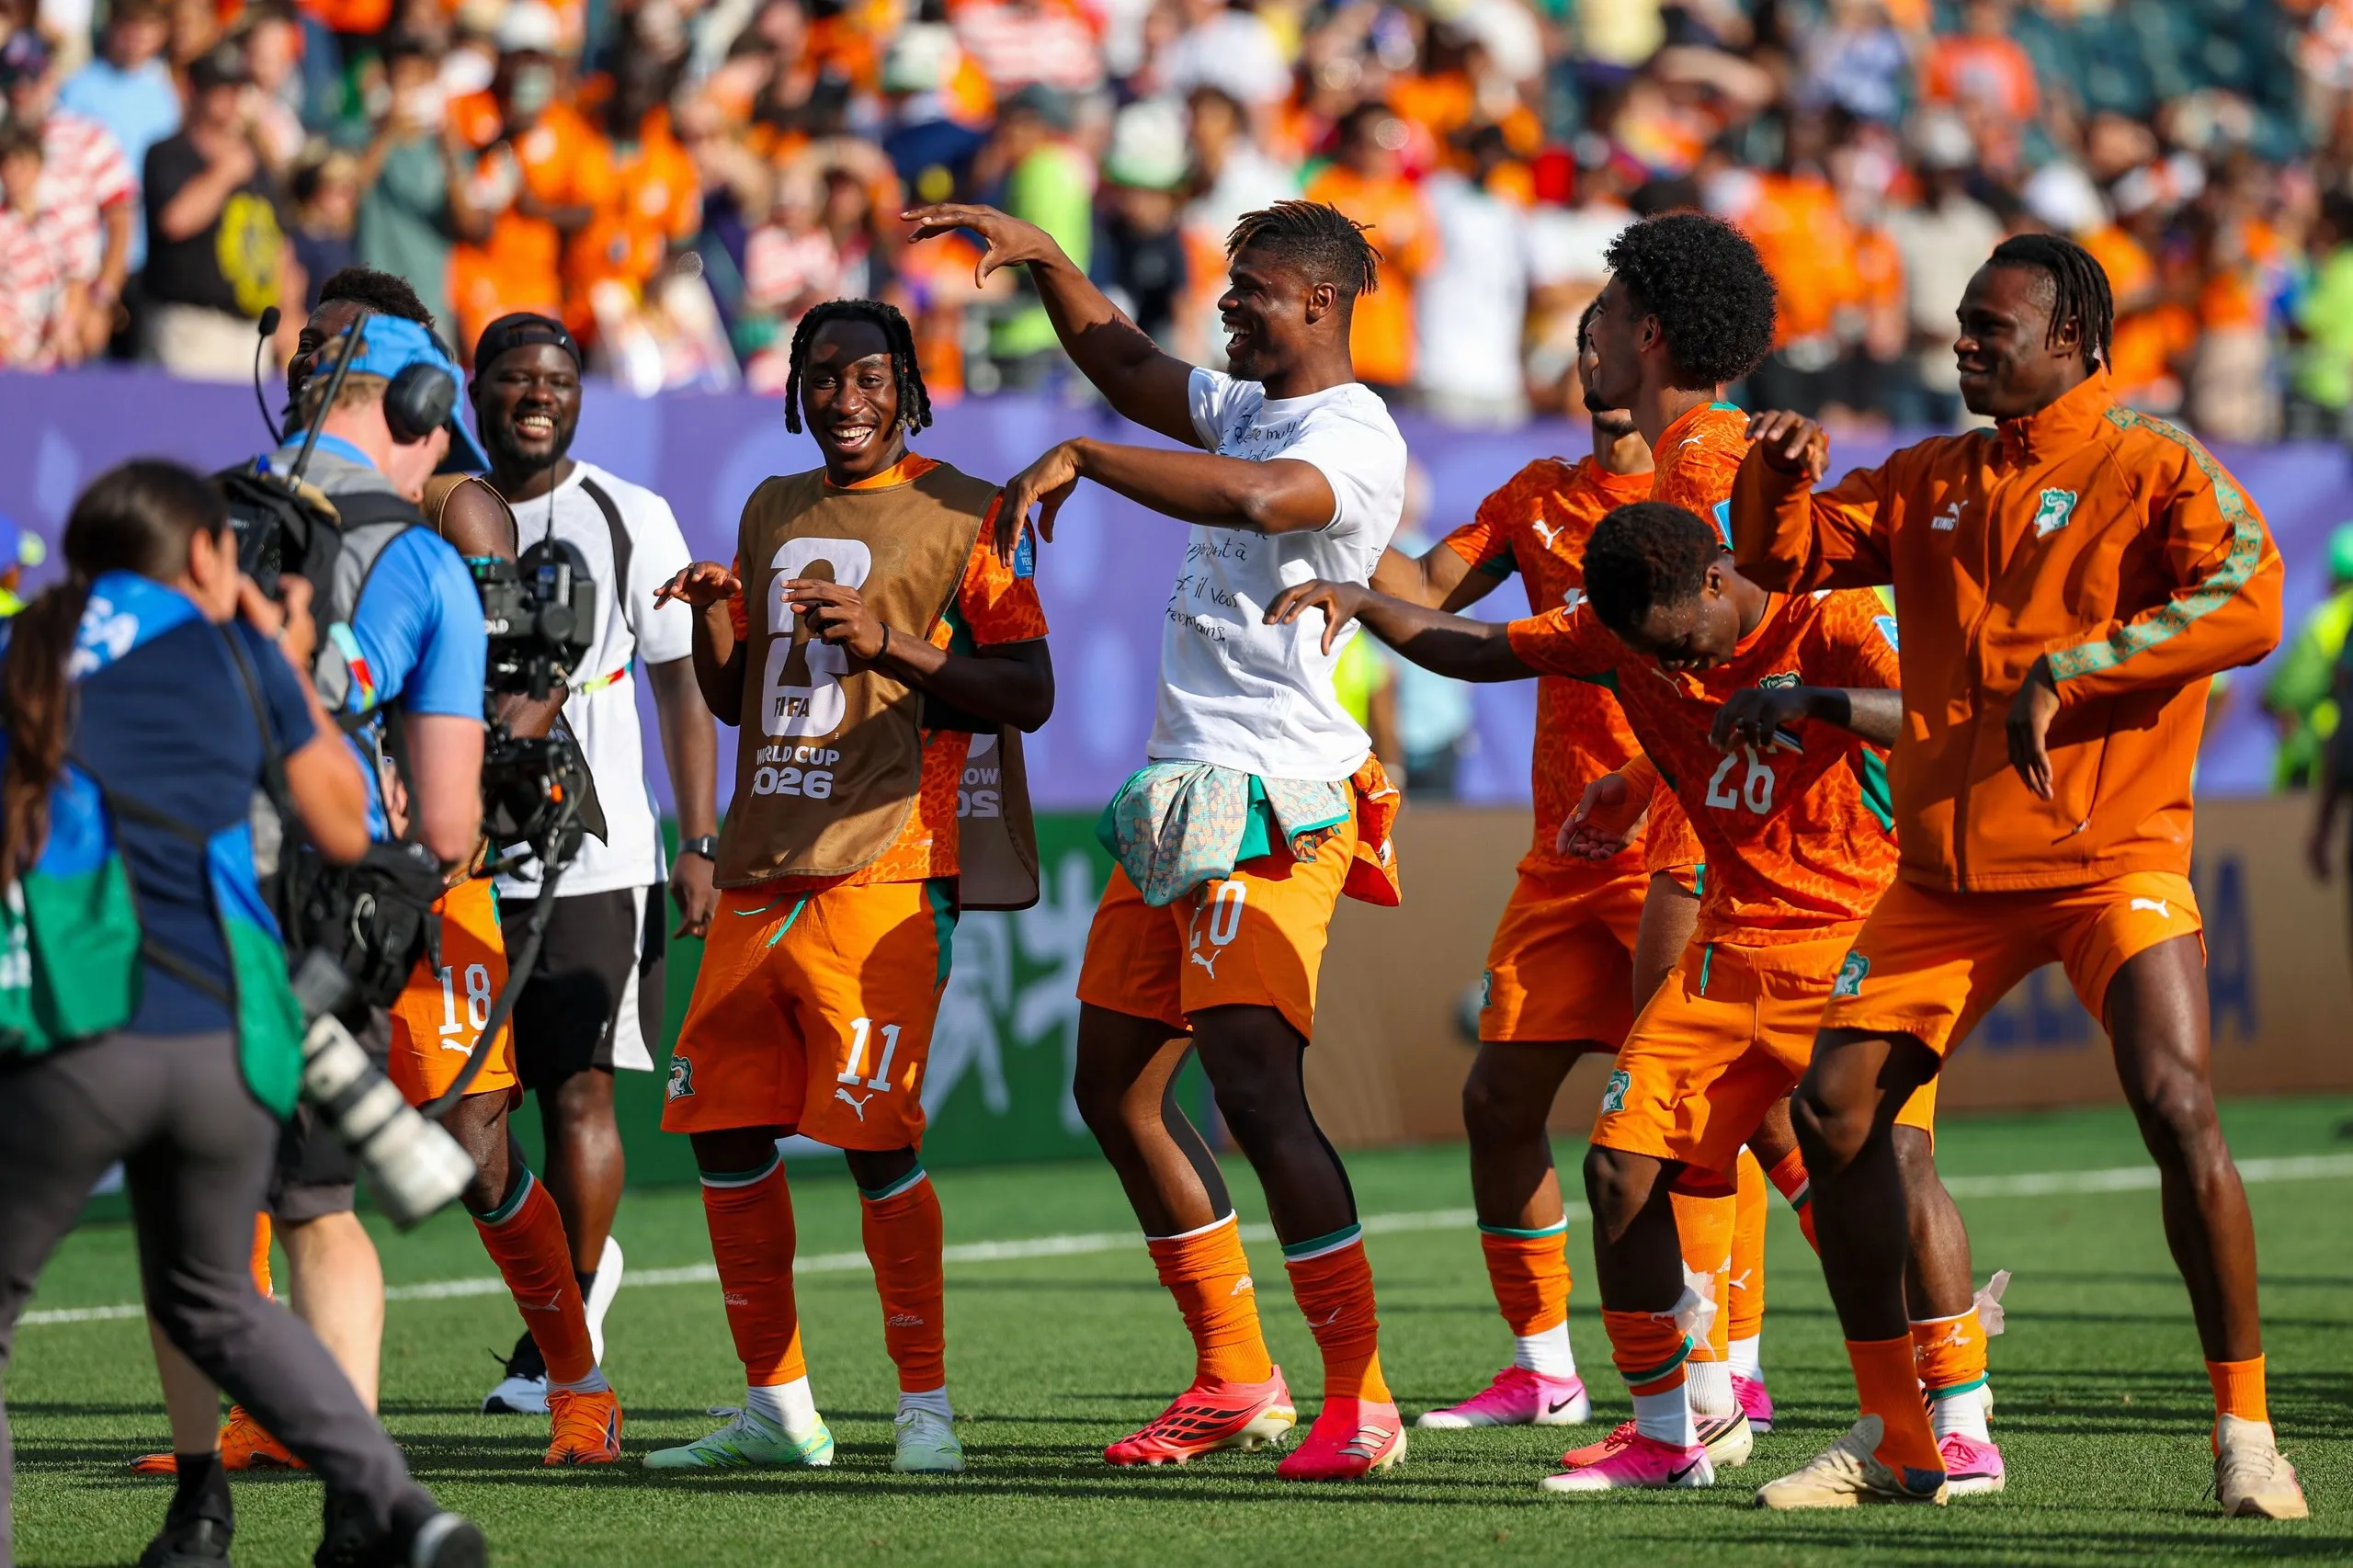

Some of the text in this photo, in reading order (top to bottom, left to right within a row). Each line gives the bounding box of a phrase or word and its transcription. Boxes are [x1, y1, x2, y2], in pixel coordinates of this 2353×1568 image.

[1931, 517, 1956, 531] KING
[774, 697, 810, 717] FIFA
[794, 745, 840, 766] CUP
[1705, 742, 1776, 815] 26
[434, 964, 491, 1036] 18
[837, 1017, 902, 1092] 11
